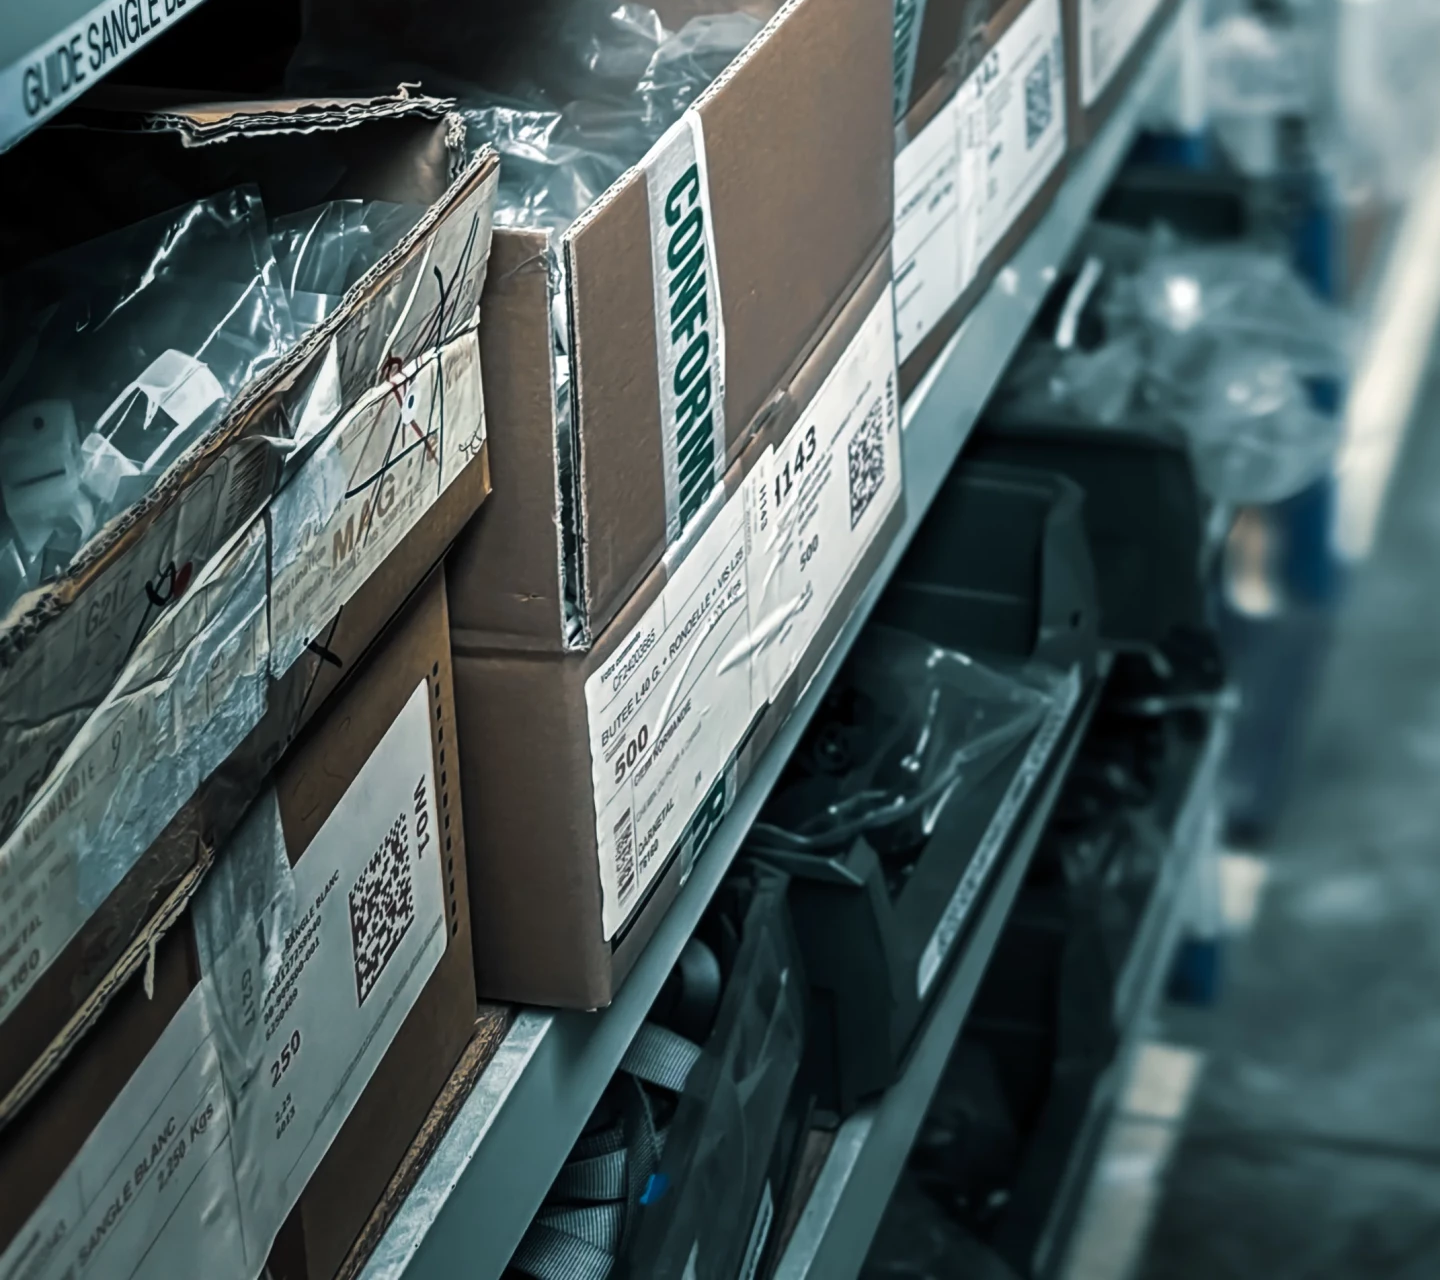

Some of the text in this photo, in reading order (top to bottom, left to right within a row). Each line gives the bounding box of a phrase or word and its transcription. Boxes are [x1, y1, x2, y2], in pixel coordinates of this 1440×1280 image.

[22, 33, 87, 118] GUIDE
[664, 161, 716, 540] CONFORME
[85, 569, 132, 639] G217
[601, 702, 634, 749] BUTEE
[667, 593, 712, 660] RONDELLE
[614, 723, 650, 785] 500
[412, 774, 430, 860] W01
[315, 869, 340, 909] BLANC
[270, 1029, 301, 1088] 250
[189, 1102, 215, 1144] Kgs
[77, 1116, 176, 1268] SANGLE BLANC
